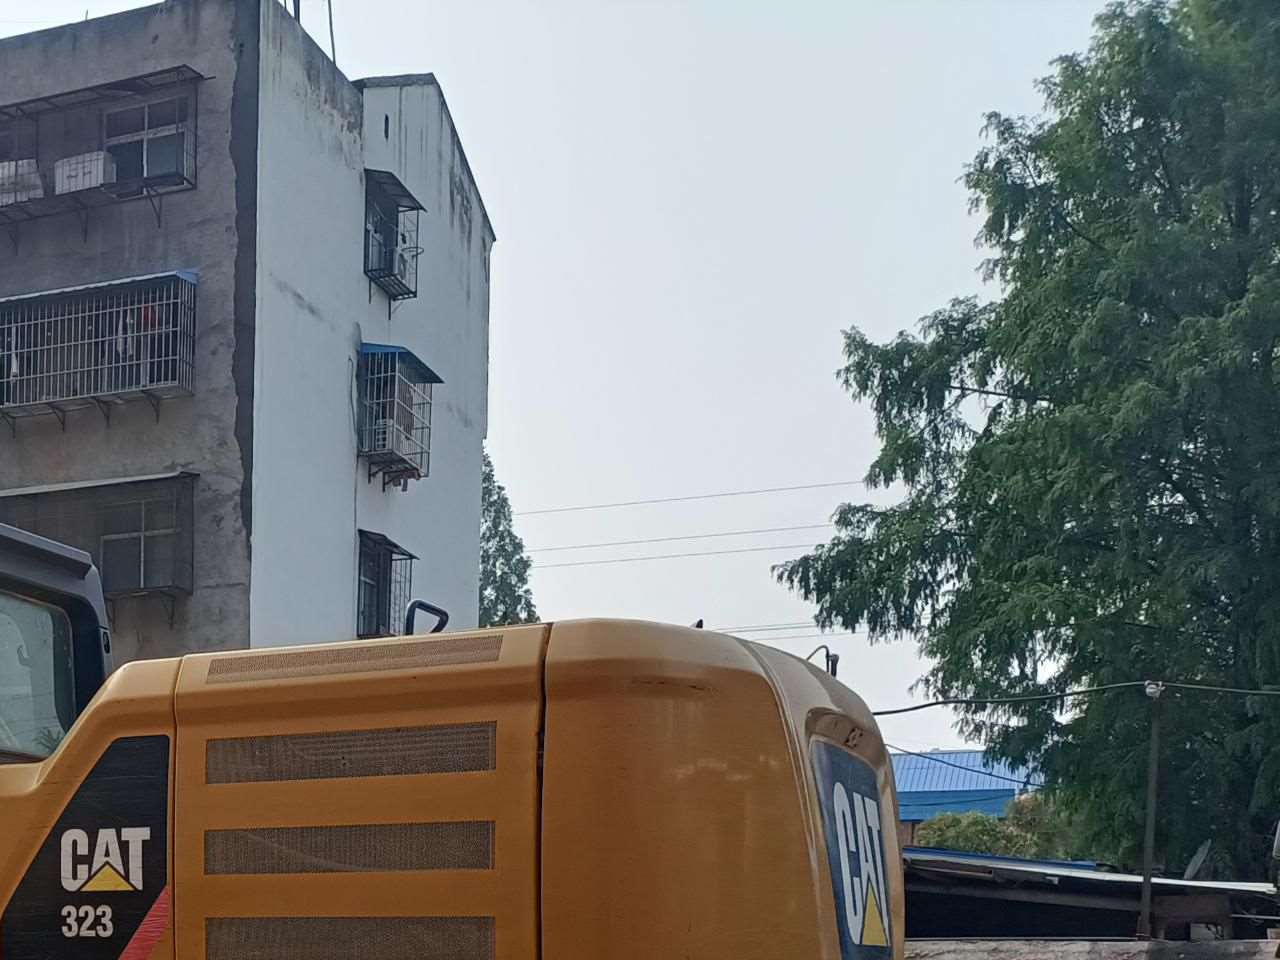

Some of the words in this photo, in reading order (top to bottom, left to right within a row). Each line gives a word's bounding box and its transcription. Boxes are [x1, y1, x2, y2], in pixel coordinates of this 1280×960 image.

[60, 827, 151, 892] CAT
[833, 781, 891, 946] CAT
[61, 905, 114, 937] 323
